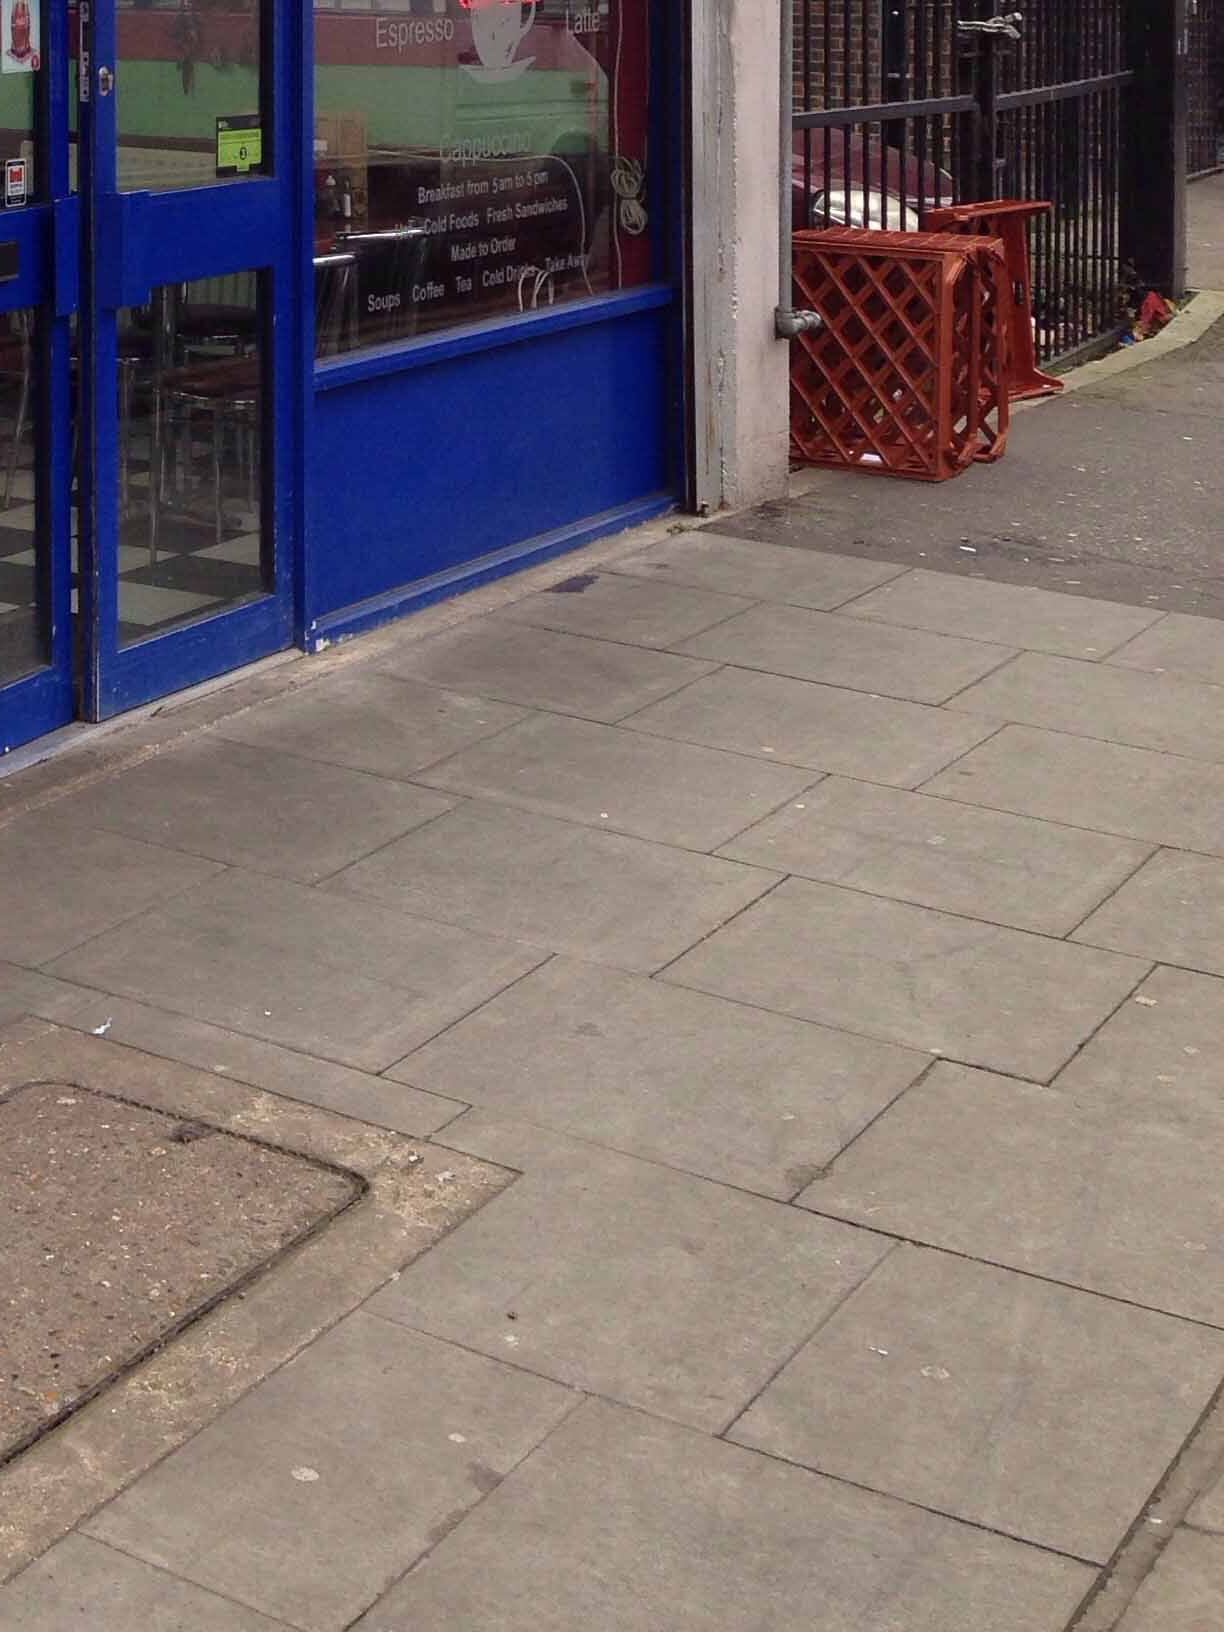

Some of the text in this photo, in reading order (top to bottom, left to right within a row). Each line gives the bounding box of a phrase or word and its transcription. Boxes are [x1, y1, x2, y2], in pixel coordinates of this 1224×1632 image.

[376, 16, 455, 53] Espresso
[565, 8, 601, 33] Latte
[417, 183, 466, 204] Breakfast
[467, 181, 489, 195] from
[423, 218, 446, 235] Cold
[448, 213, 480, 232] Foods
[486, 207, 514, 224] Fresh
[515, 197, 569, 219] Sandwiches
[451, 244, 477, 262] Made
[490, 237, 517, 255] Order
[367, 292, 400, 313] Soups
[412, 281, 445, 302] Coffee
[455, 276, 472, 293] Tea
